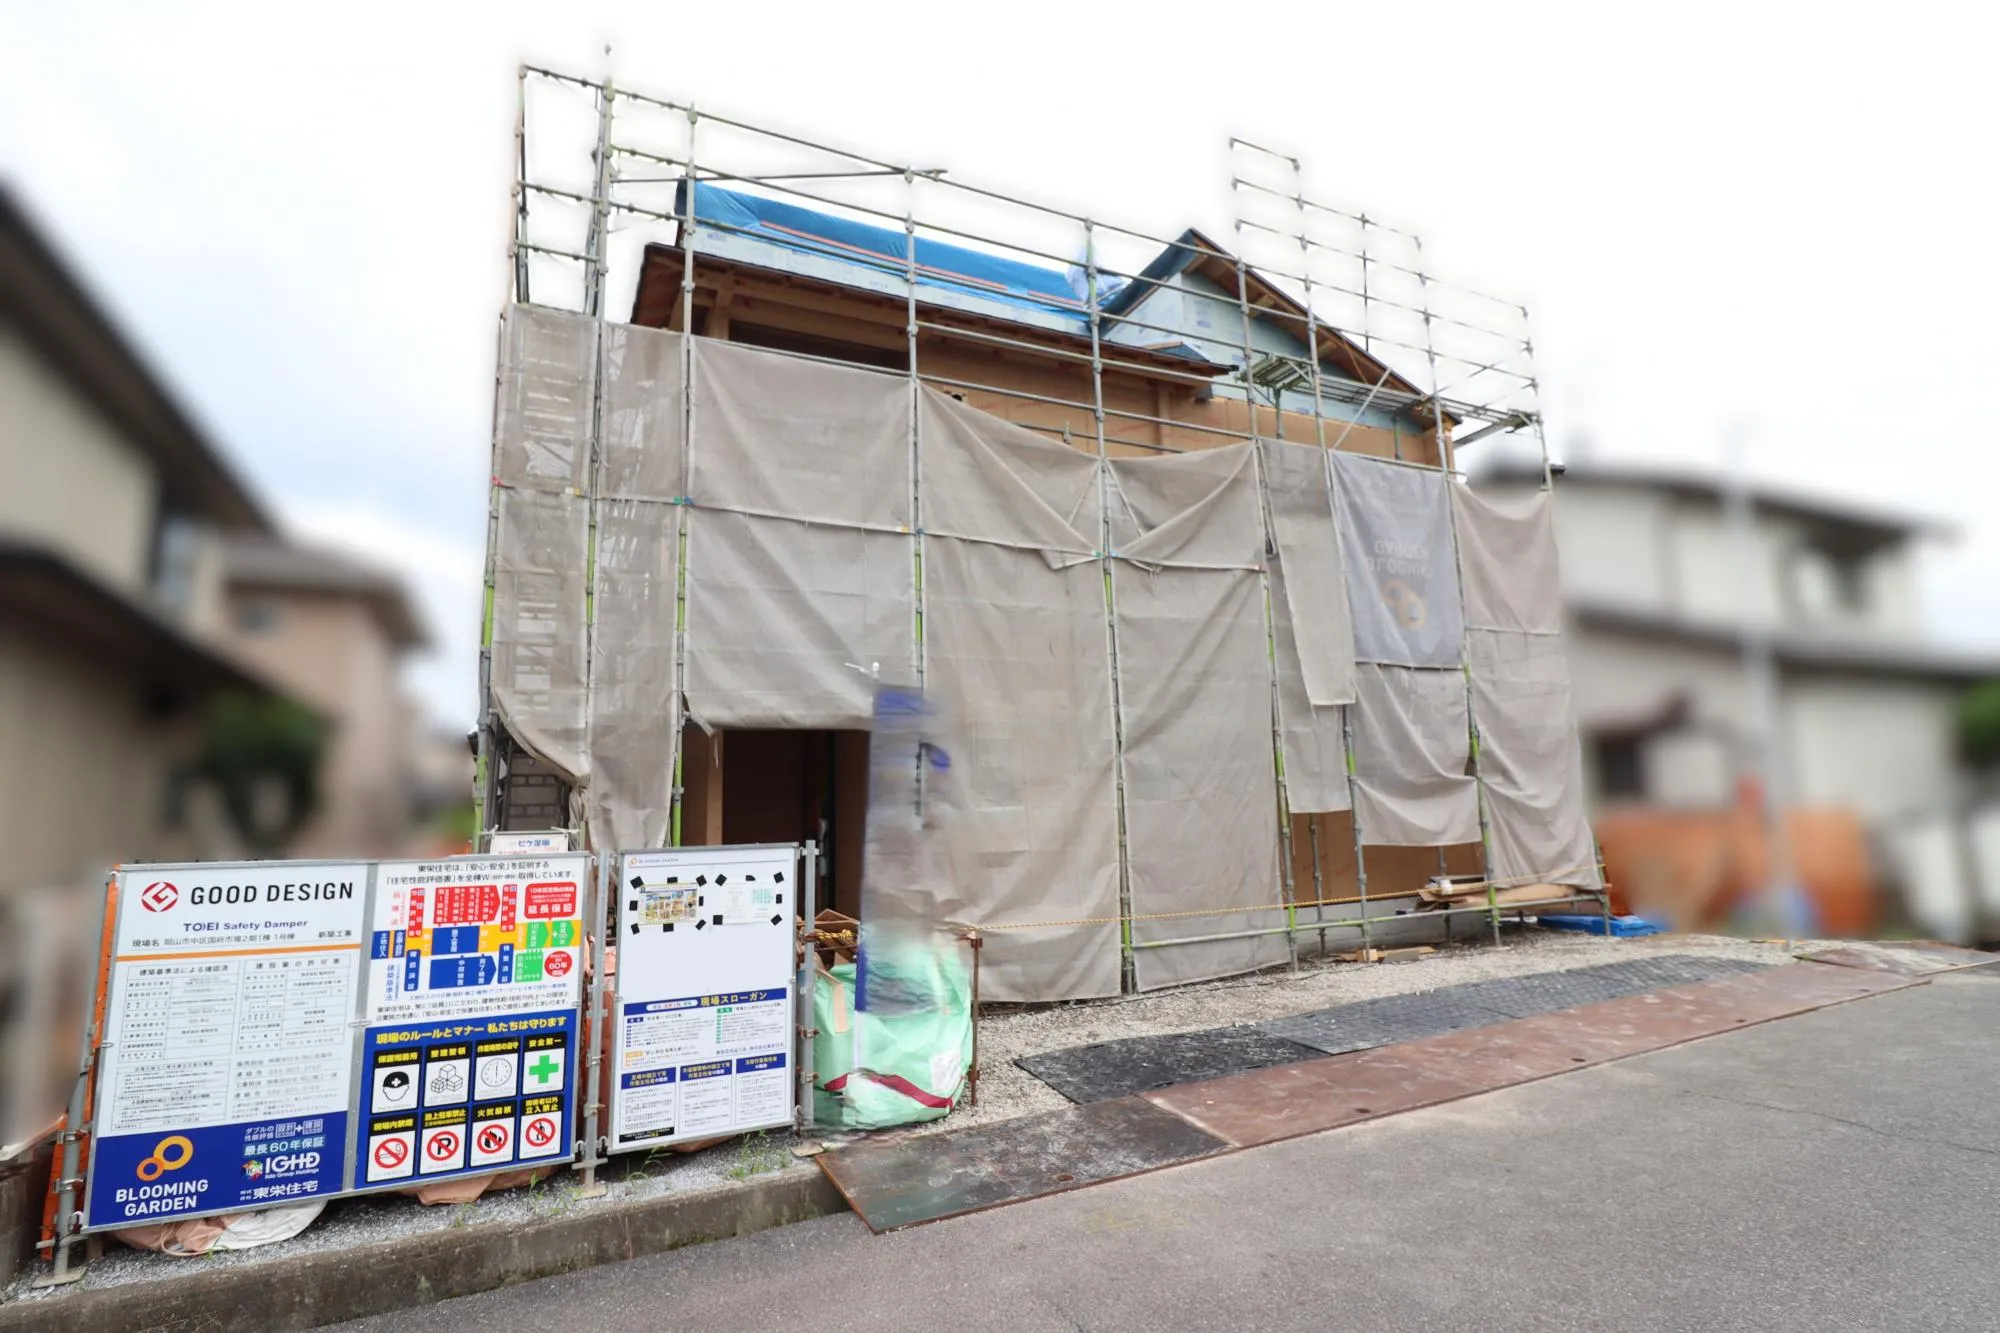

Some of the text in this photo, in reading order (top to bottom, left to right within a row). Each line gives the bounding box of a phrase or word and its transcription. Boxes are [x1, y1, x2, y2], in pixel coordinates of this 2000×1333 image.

[190, 882, 353, 905] GOOD DESIGN
[223, 921, 261, 931] Safety
[264, 919, 308, 930] Damper
[132, 938, 160, 948] 現場名
[318, 930, 352, 939] 新築工事
[700, 992, 768, 1007] 現場スローガン
[376, 1016, 567, 1045] 現場のルールとマナー 私たちは守ります
[528, 1038, 562, 1048] 安全第一
[477, 1106, 512, 1118] 火気厳禁
[525, 1104, 559, 1115] 立入禁止
[246, 1126, 274, 1135] ダブルの
[244, 1136, 325, 1156] 最長60年保証
[265, 1152, 320, 1174] IGHD
[277, 1171, 294, 1179] Group
[115, 1179, 208, 1203] BLOOMING
[253, 1180, 319, 1200] 東栄住宅
[124, 1195, 197, 1217] GARDEN
